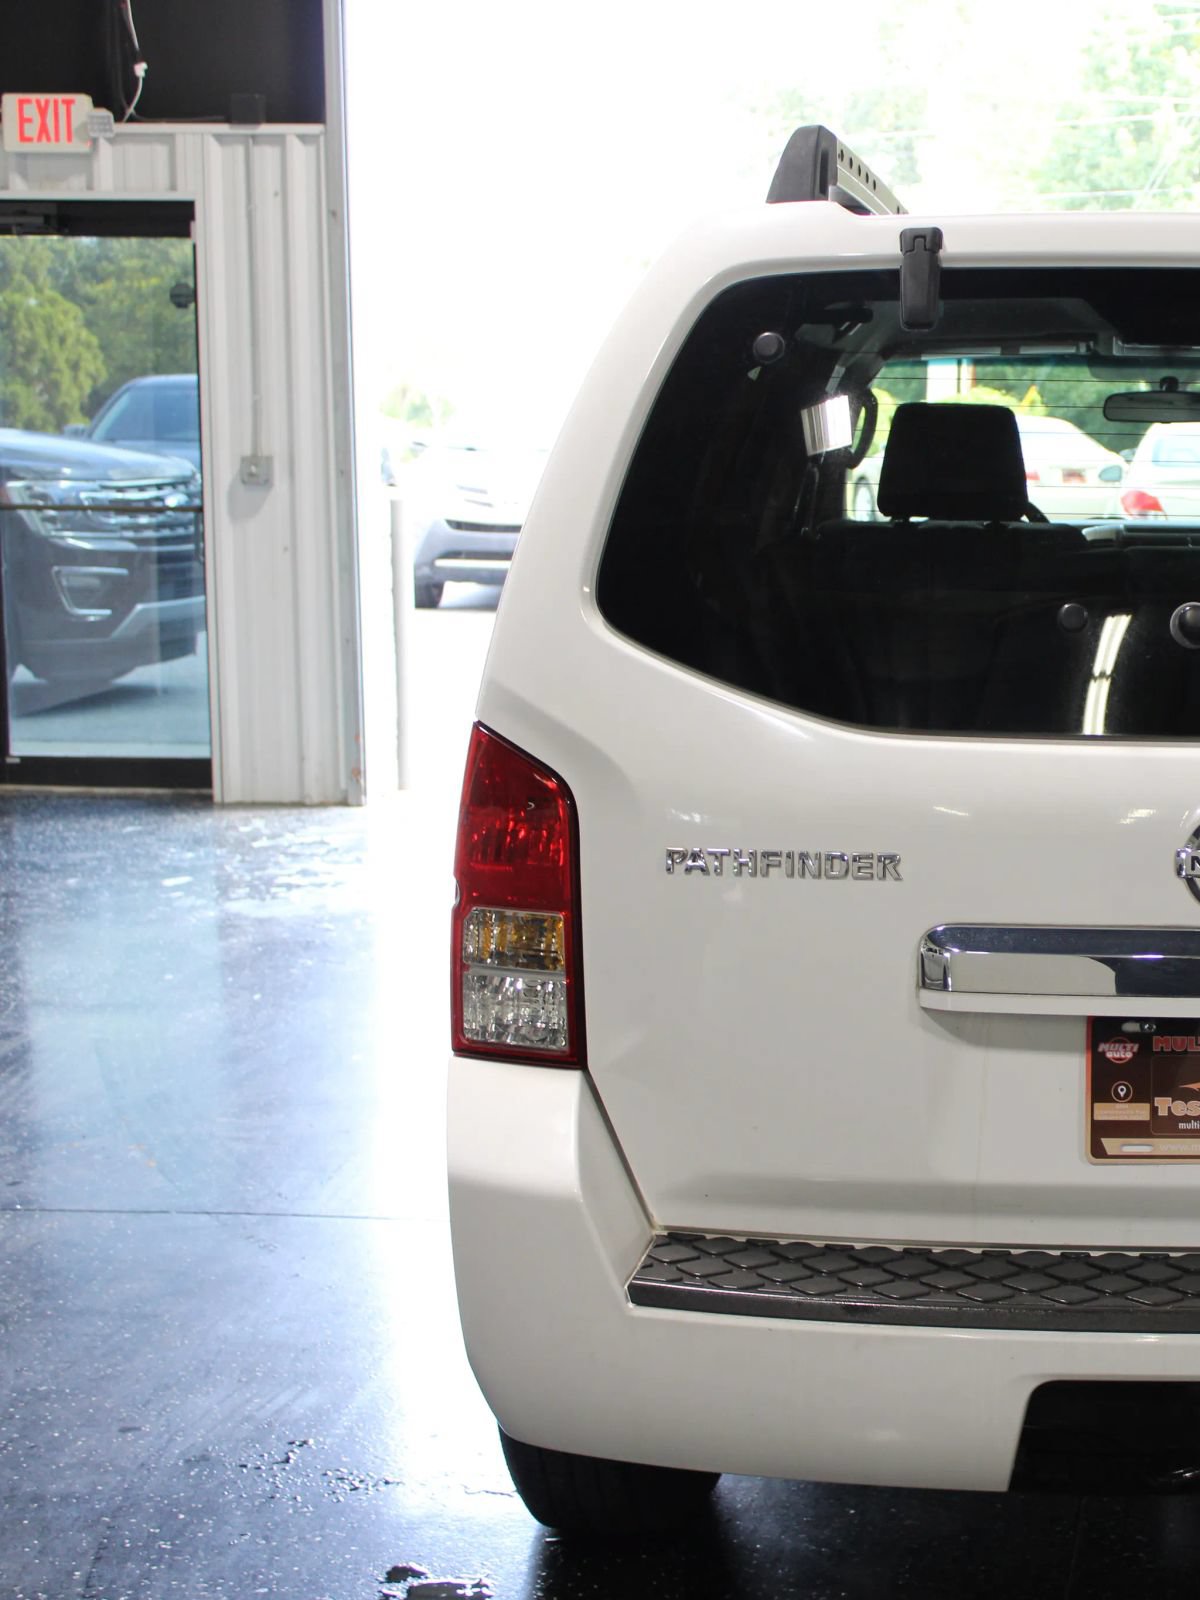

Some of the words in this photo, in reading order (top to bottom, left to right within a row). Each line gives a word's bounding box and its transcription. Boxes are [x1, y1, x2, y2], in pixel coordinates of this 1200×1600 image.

[17, 98, 76, 144] EXIT
[665, 846, 904, 881] PATHFINDER
[1098, 1043, 1139, 1052] MULTI
